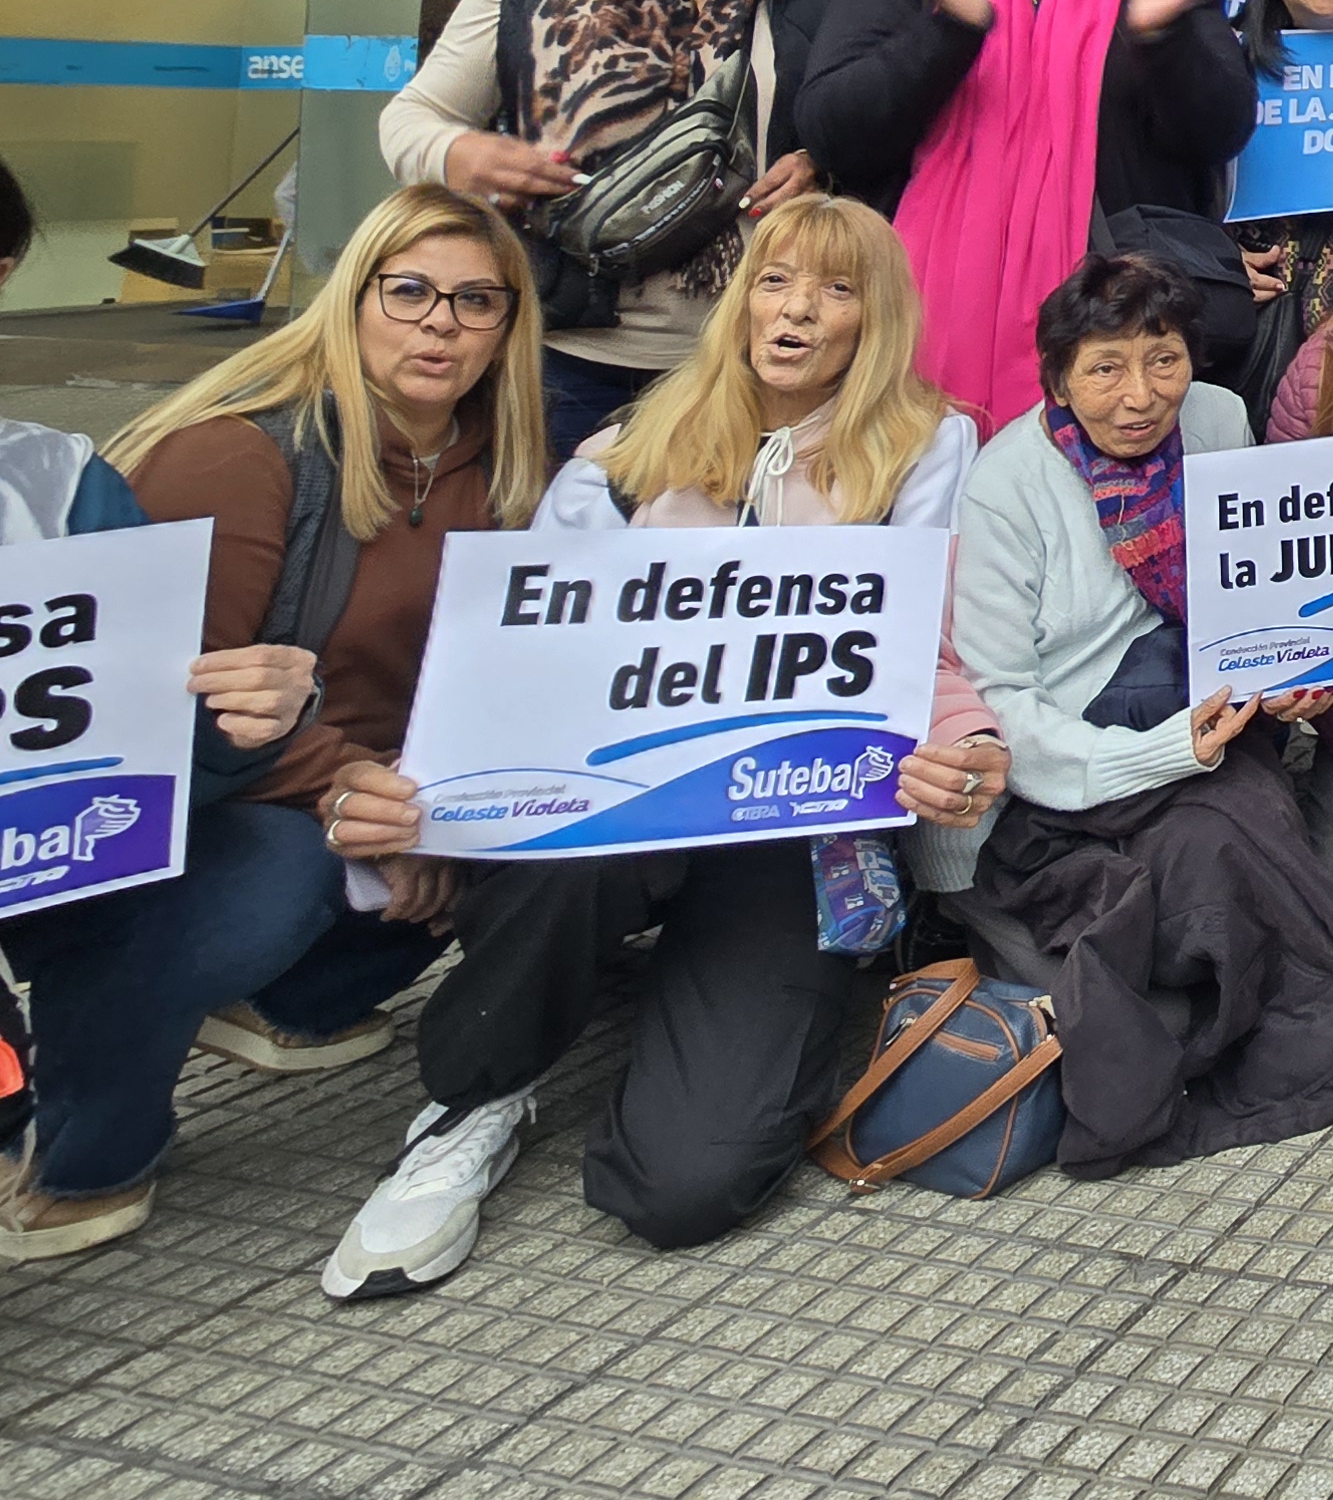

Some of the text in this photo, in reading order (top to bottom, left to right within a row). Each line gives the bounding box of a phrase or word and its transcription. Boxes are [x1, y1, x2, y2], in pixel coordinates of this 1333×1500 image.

[1283, 64, 1323, 91] EN
[1288, 96, 1327, 123] LA
[1218, 493, 1265, 531] En
[1219, 553, 1257, 590] la
[500, 560, 886, 627] En defensa
[608, 630, 878, 712] del IPS
[1275, 644, 1330, 664] Violeta
[728, 756, 851, 801] Suteba
[510, 797, 590, 819] Violeta
